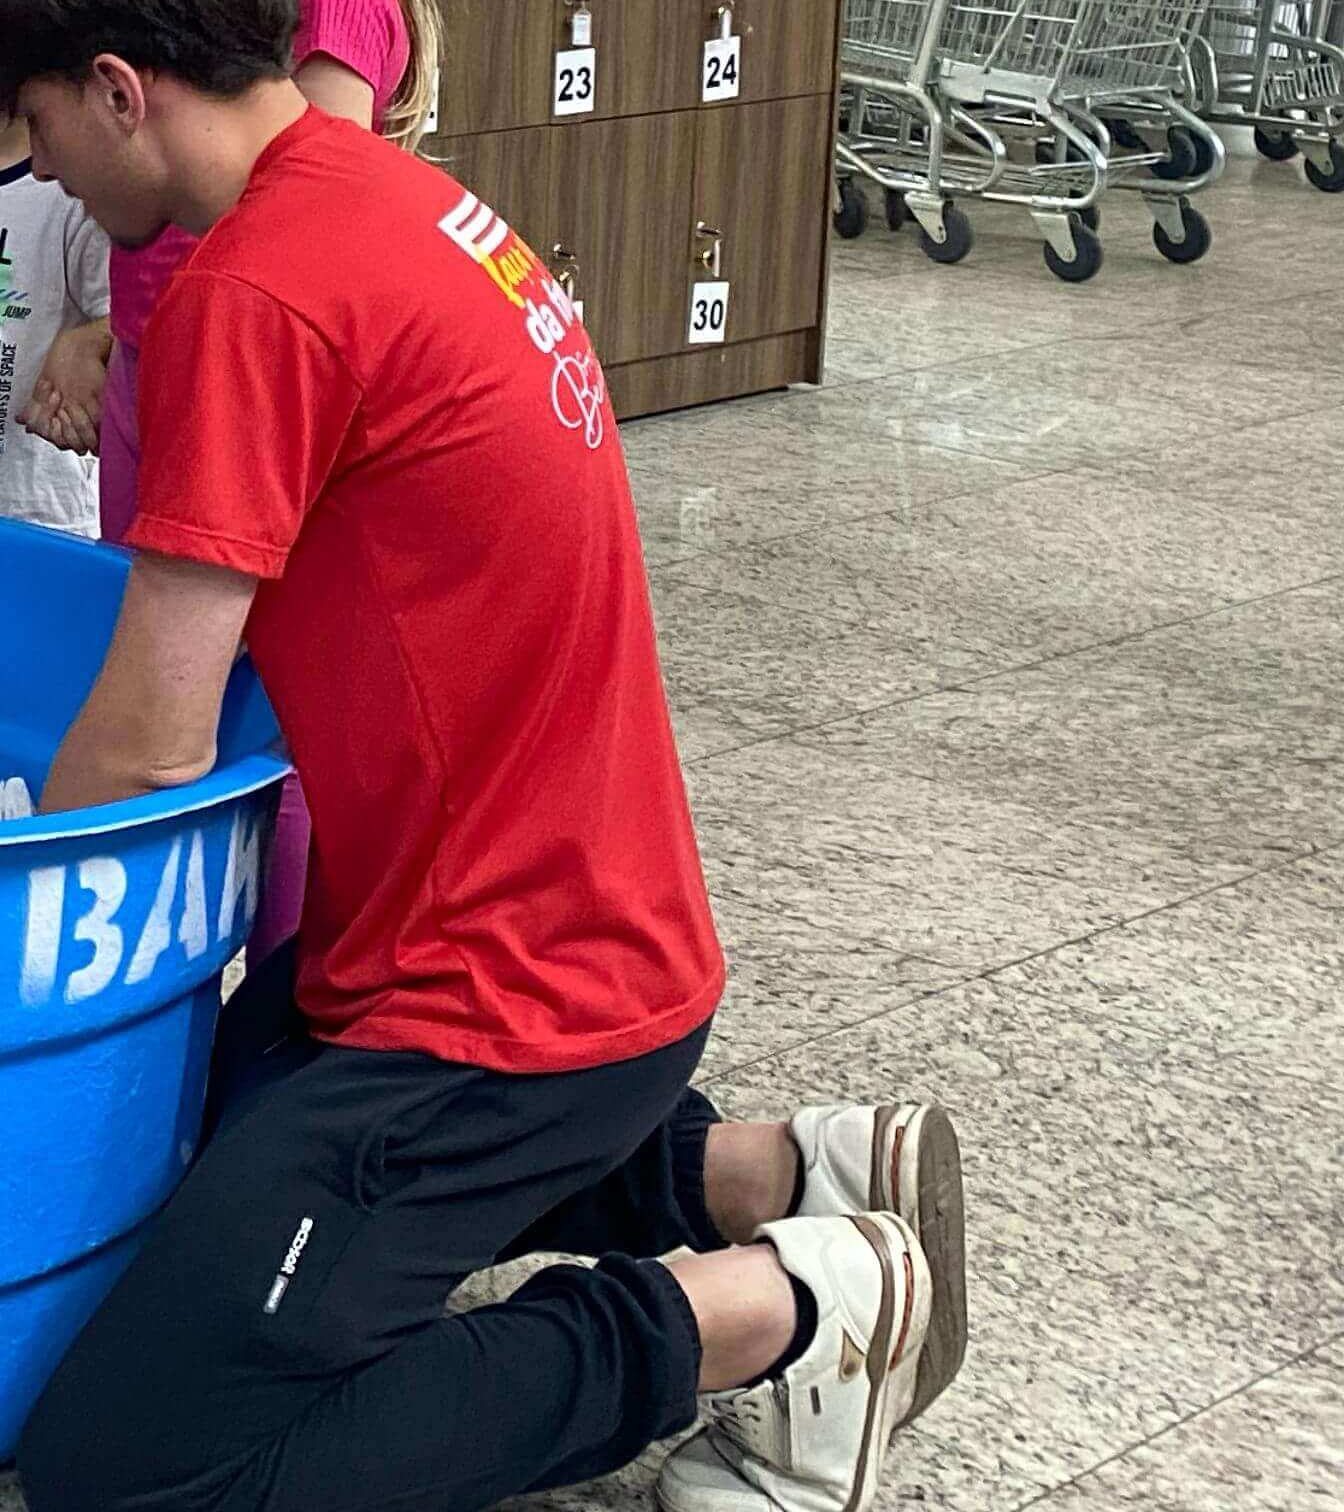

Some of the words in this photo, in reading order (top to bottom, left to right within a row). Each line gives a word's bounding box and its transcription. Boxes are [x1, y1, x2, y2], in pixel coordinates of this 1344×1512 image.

[558, 68, 591, 102] 23
[706, 57, 737, 89] 24
[693, 300, 724, 331] 30
